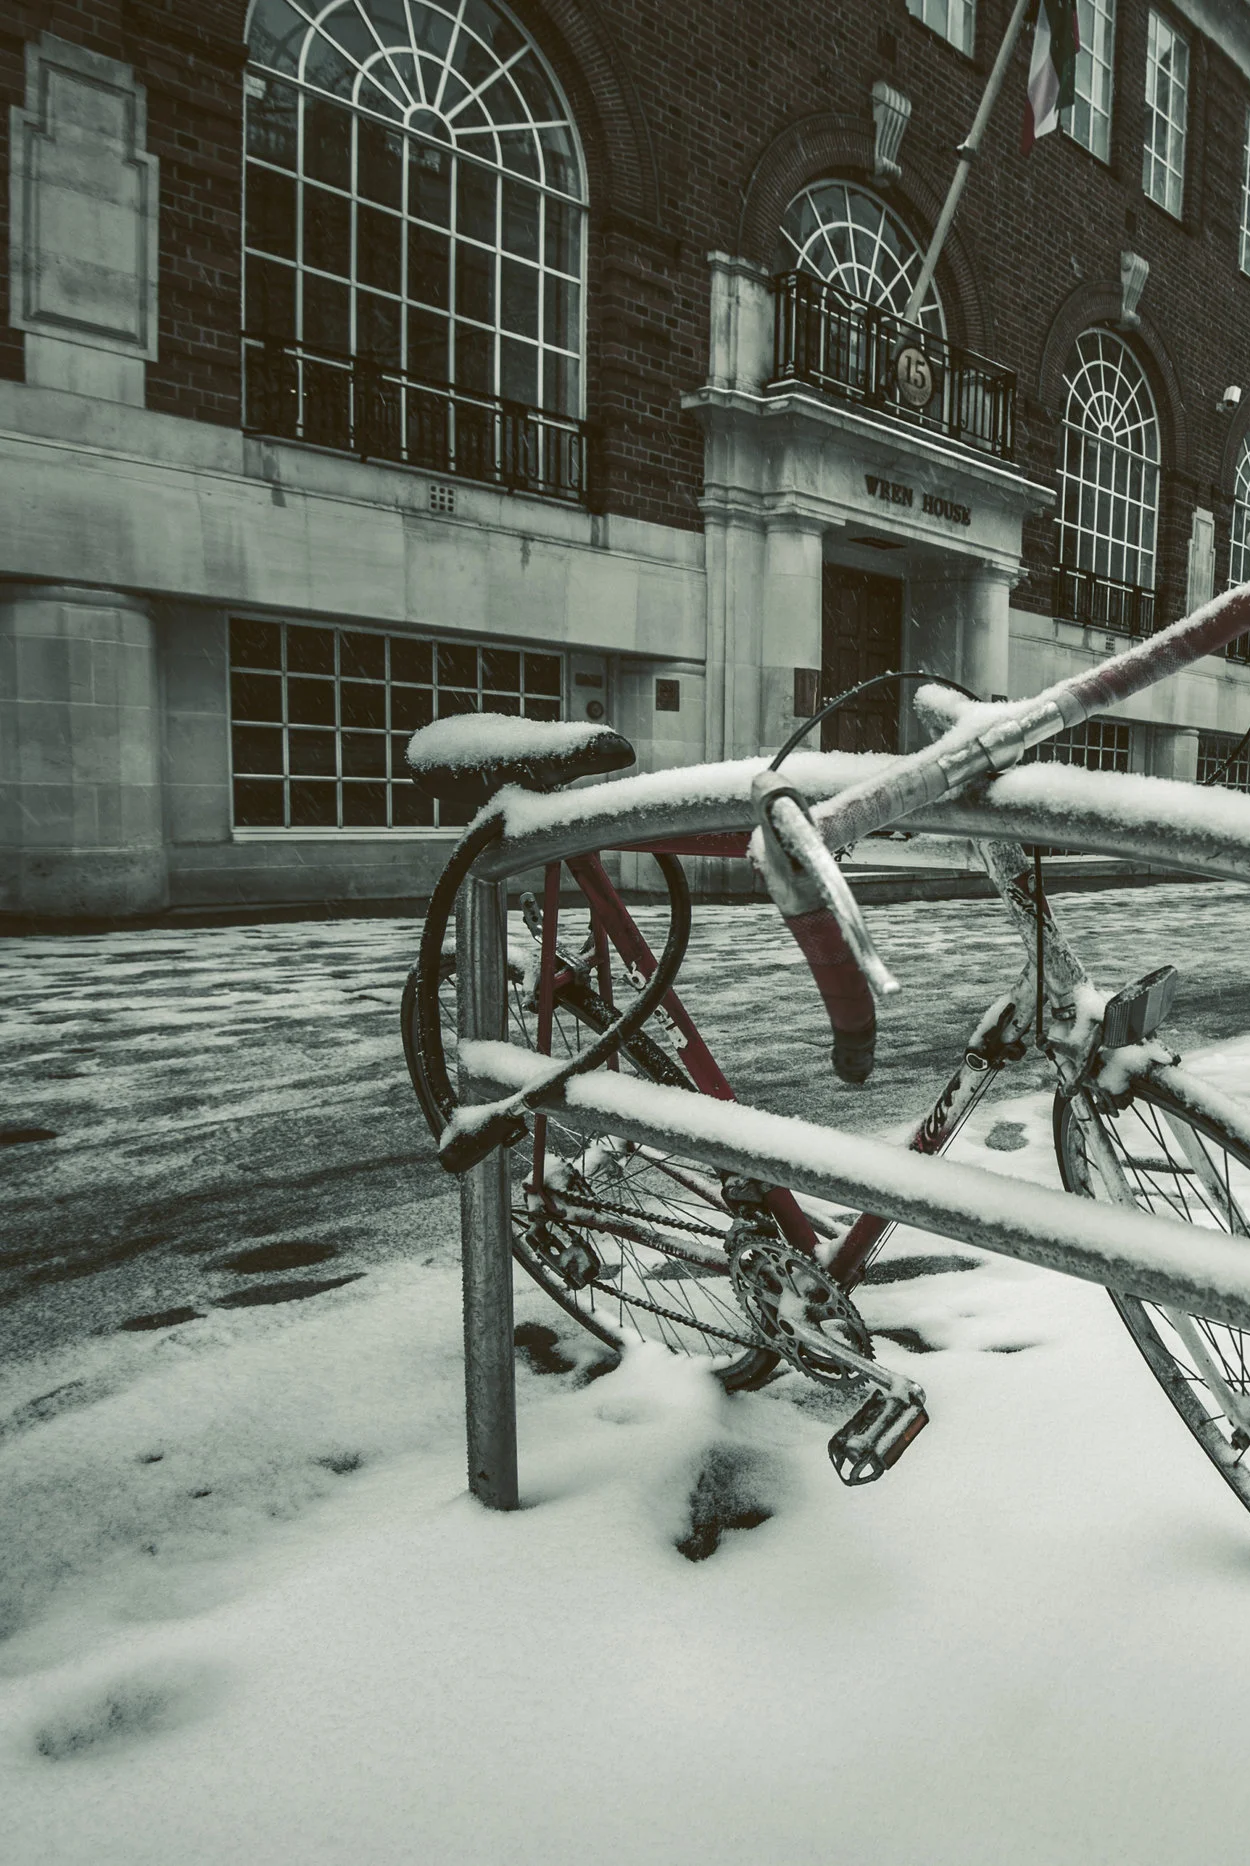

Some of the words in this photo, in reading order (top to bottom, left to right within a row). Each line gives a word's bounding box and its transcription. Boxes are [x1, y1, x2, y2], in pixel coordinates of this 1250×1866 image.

[905, 355, 926, 389] 15
[865, 474, 913, 508] WREN
[922, 493, 972, 527] HOUSE
